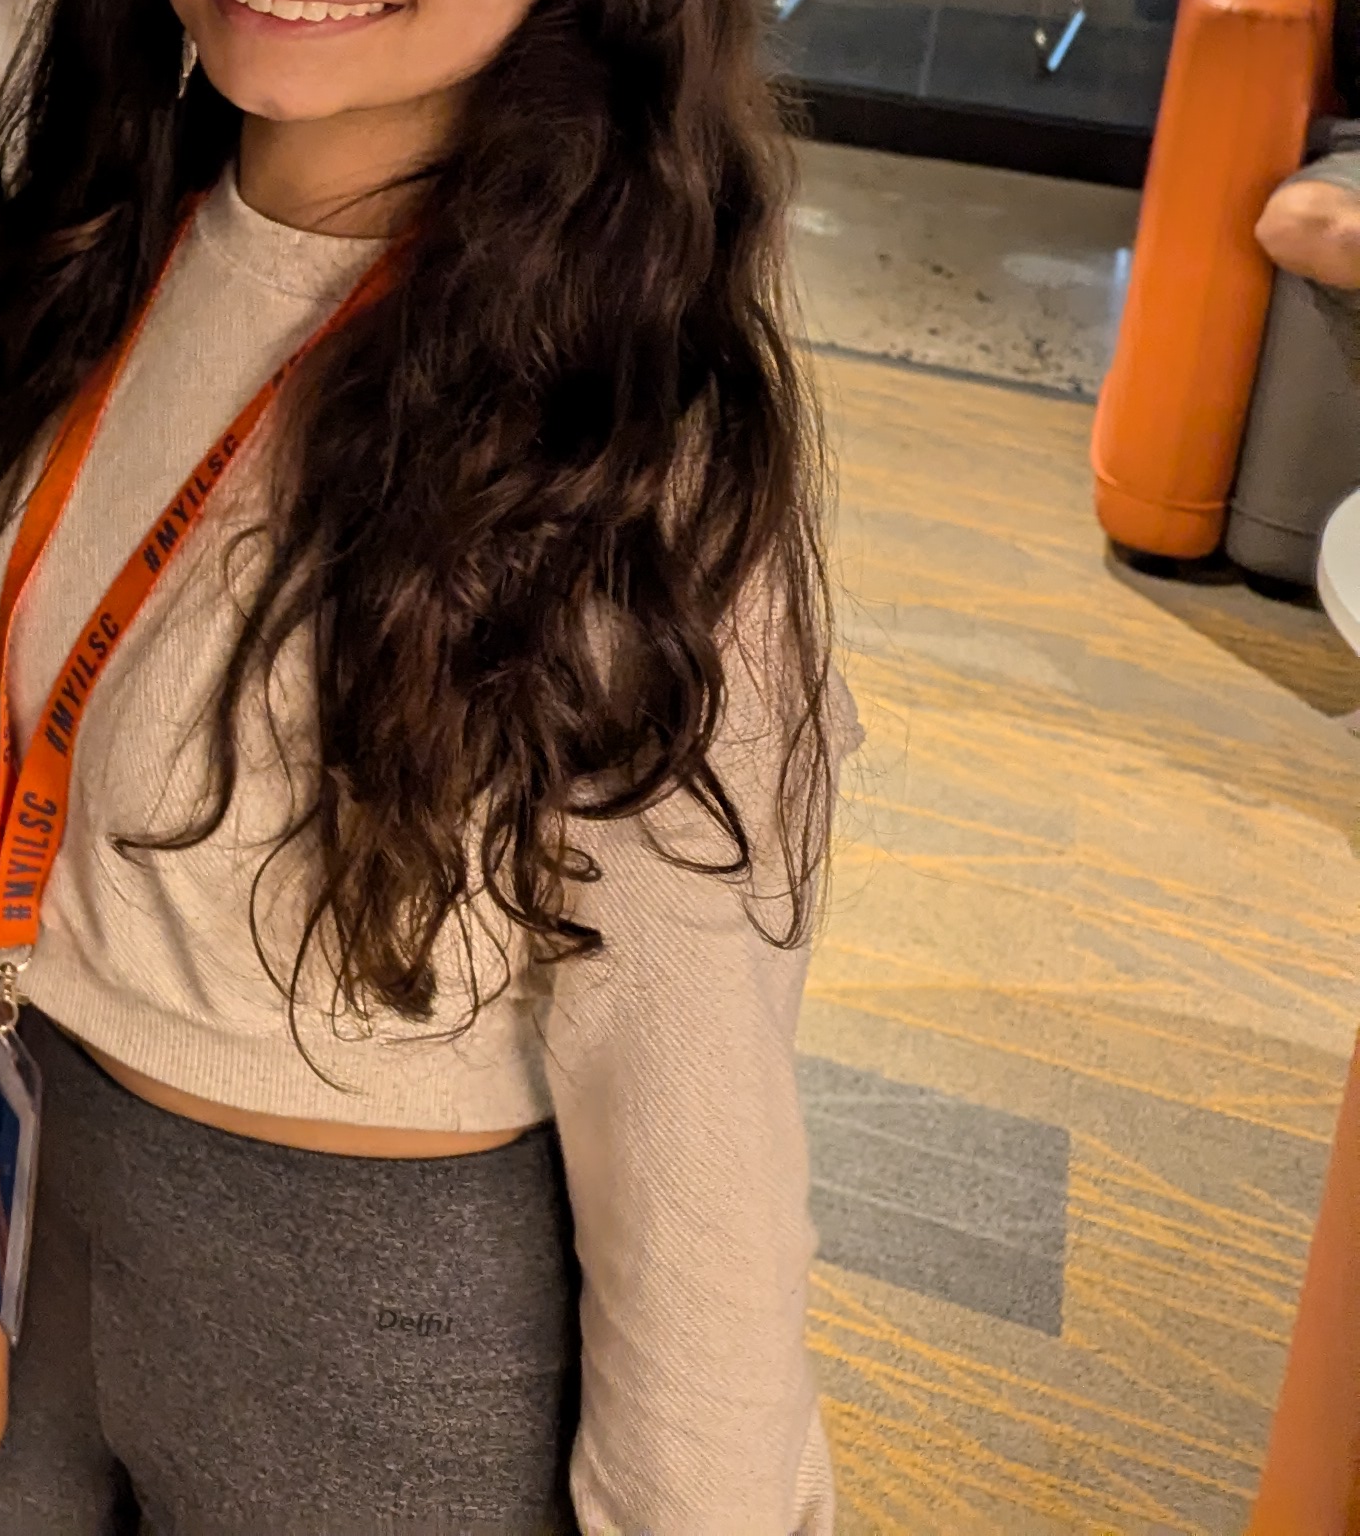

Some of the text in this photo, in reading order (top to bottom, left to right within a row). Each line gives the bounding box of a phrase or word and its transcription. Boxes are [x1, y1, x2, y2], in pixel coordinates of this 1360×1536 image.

[142, 433, 241, 575] #MYILSC
[44, 611, 121, 759] #MYILSC
[2, 790, 58, 922] #MYILSC
